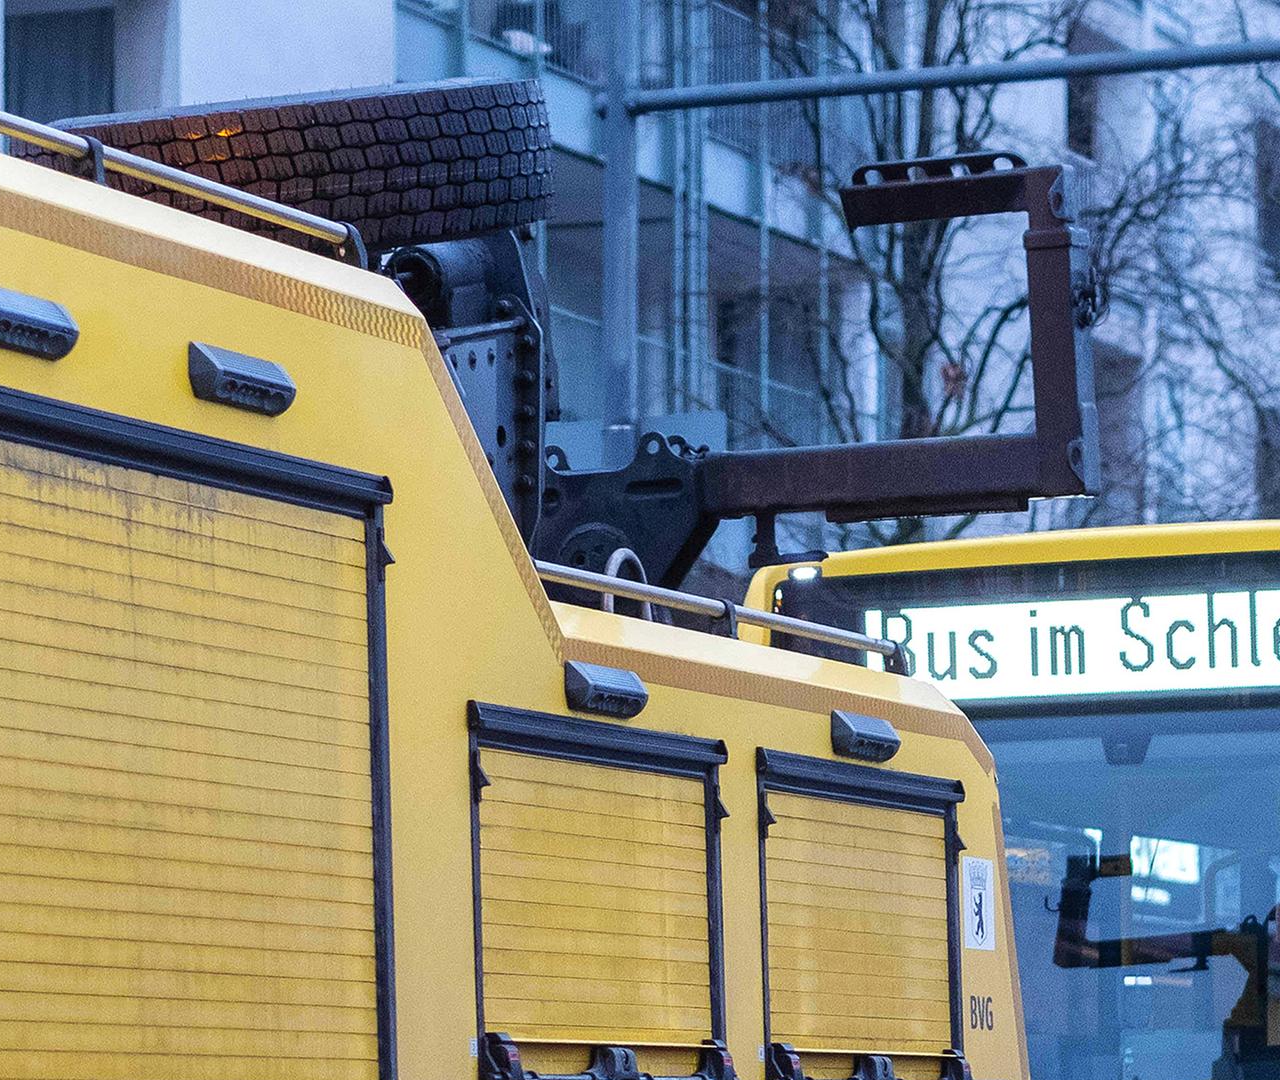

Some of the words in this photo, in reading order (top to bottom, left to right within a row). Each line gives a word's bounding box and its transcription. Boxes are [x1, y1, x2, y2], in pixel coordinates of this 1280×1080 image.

[881, 612, 998, 681] Bus
[1029, 609, 1086, 677] im
[969, 994, 994, 1031] BVG
